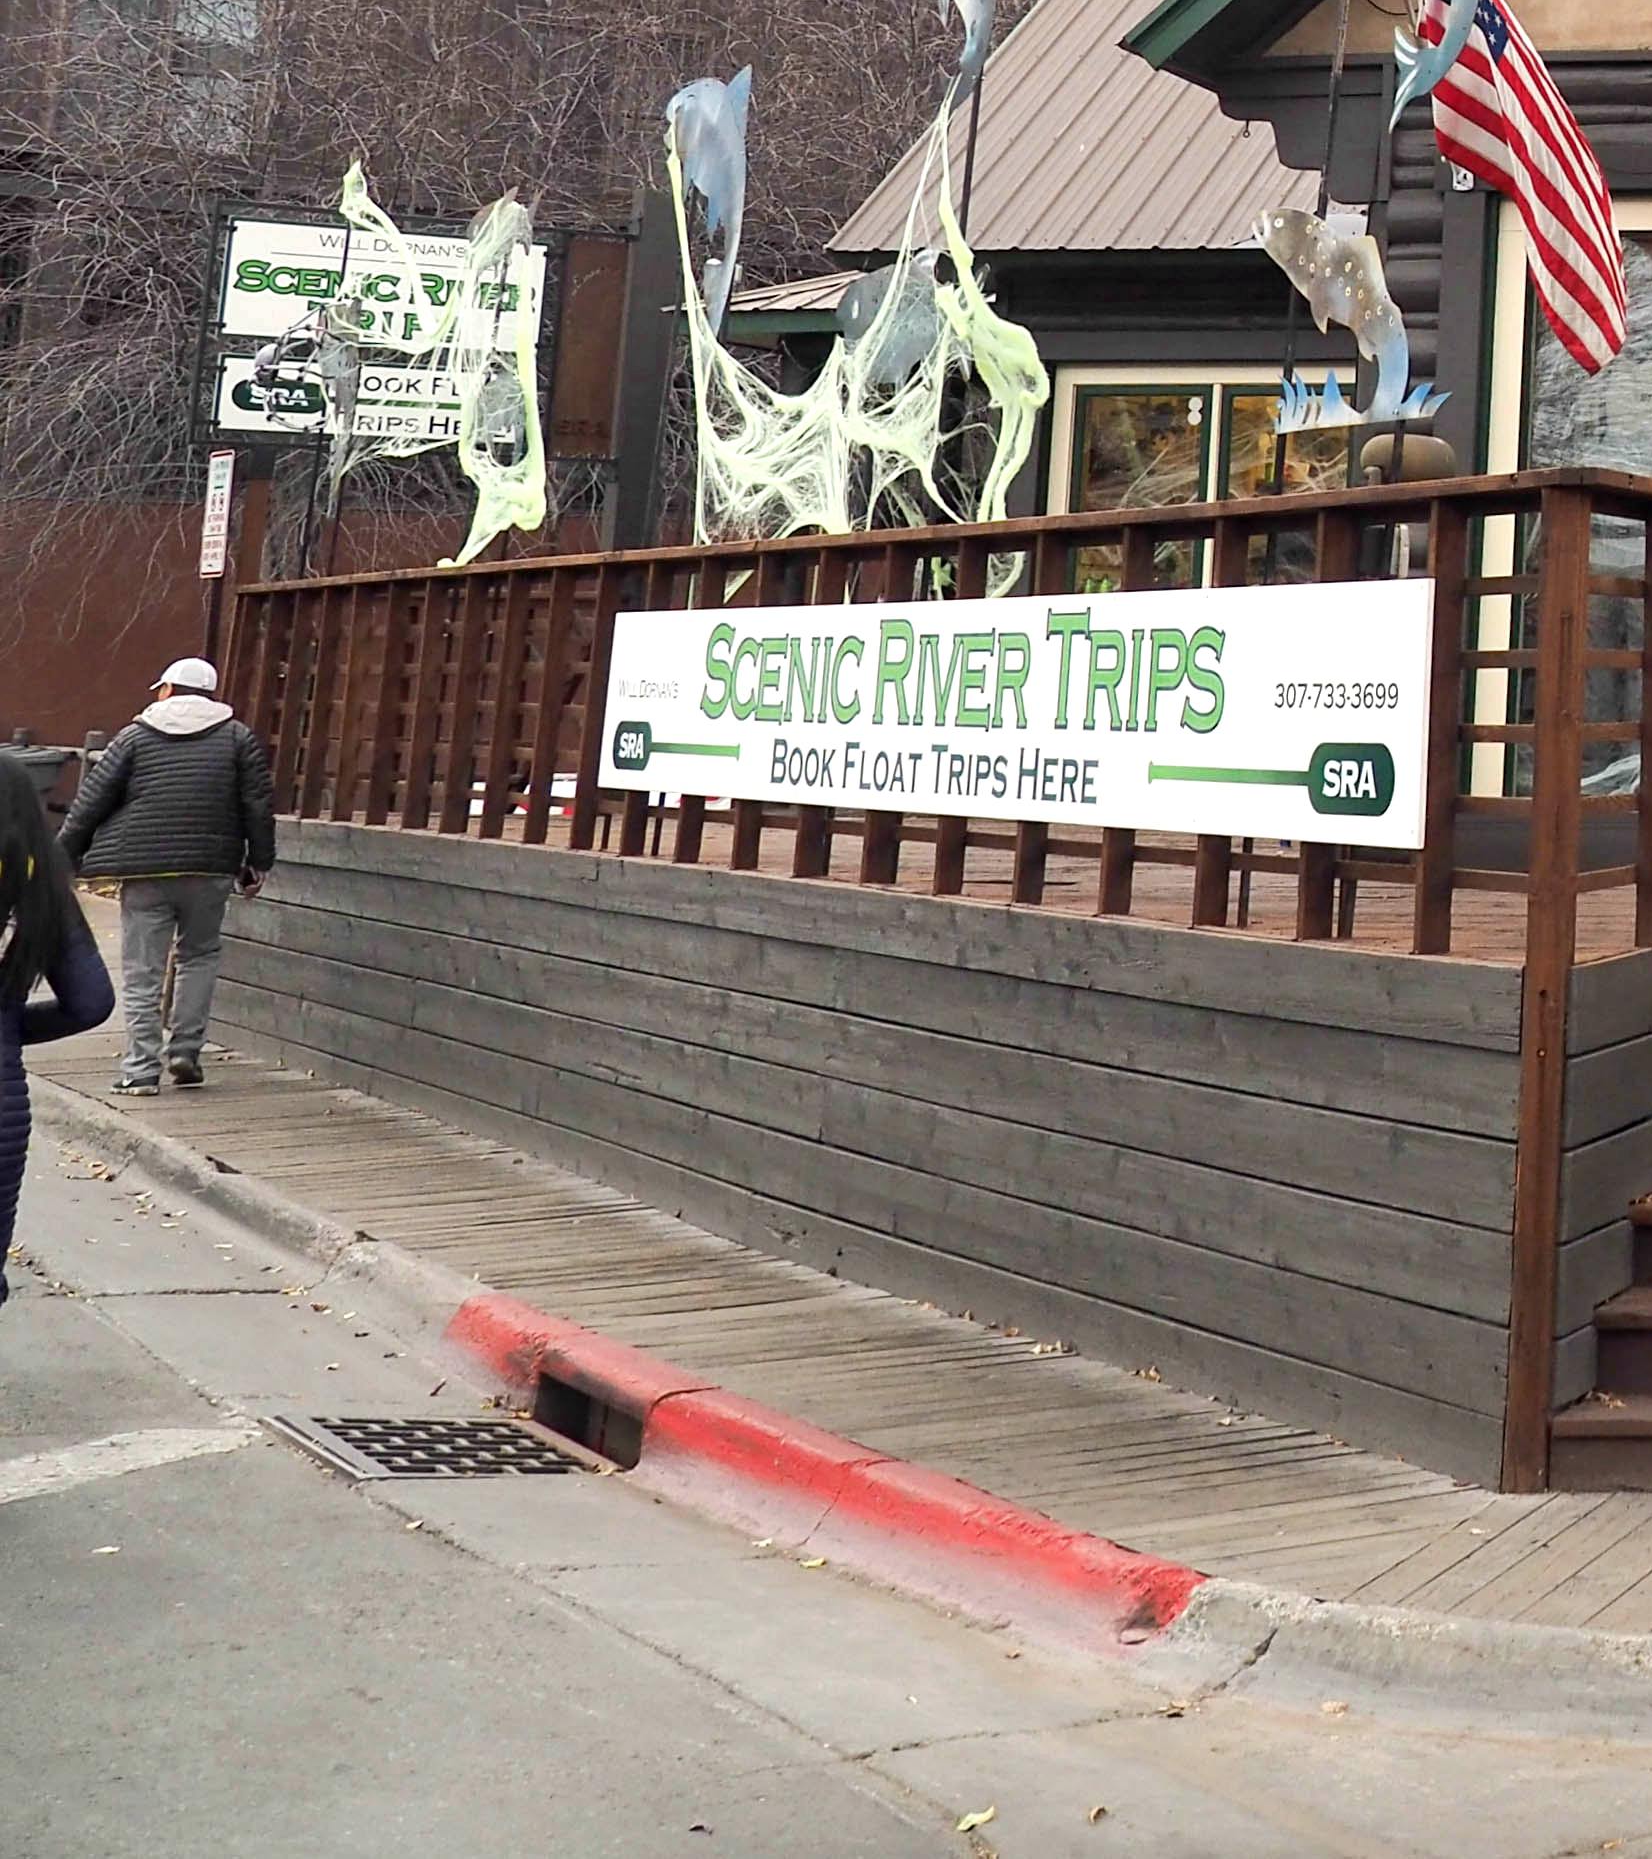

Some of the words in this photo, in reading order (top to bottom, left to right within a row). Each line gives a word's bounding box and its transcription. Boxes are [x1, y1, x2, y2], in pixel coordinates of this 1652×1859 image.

[357, 376, 422, 395] OOK
[357, 415, 420, 433] RIPS
[700, 623, 865, 725] SCENIC
[872, 618, 1031, 732] RIVER
[1046, 607, 1226, 734] TRIPS
[618, 732, 644, 759] SRA
[770, 738, 836, 788] BOOK
[842, 741, 922, 793] FLOAT
[931, 743, 1008, 798] TRIPS
[1017, 747, 1099, 804] HERE
[1322, 760, 1377, 799] SRA
